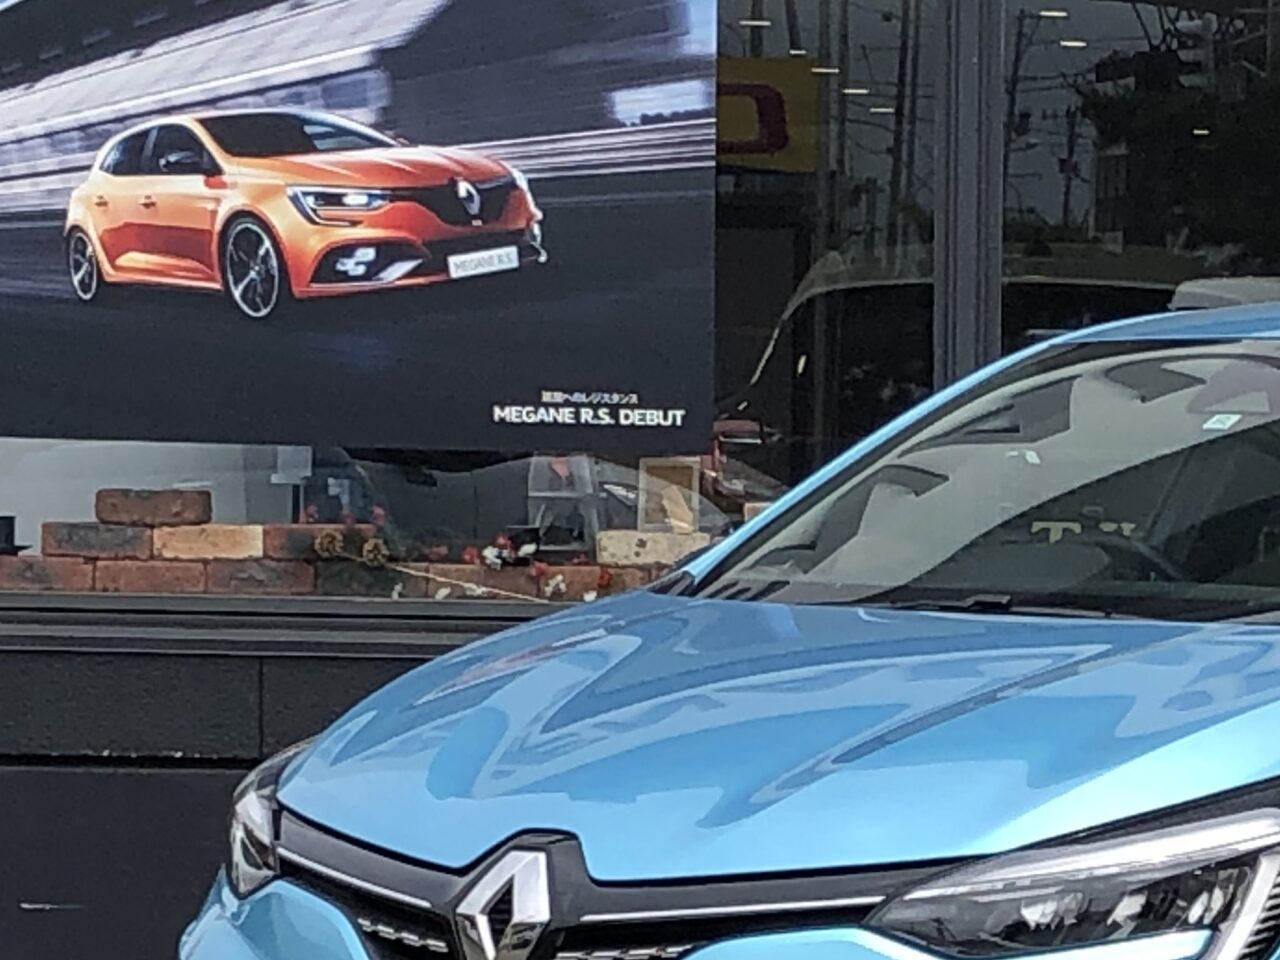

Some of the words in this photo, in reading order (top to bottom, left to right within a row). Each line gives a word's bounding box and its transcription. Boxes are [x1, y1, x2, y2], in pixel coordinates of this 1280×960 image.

[493, 405, 576, 423] MEGANE
[580, 407, 616, 425] R.S.
[619, 409, 686, 426] DEBUT
